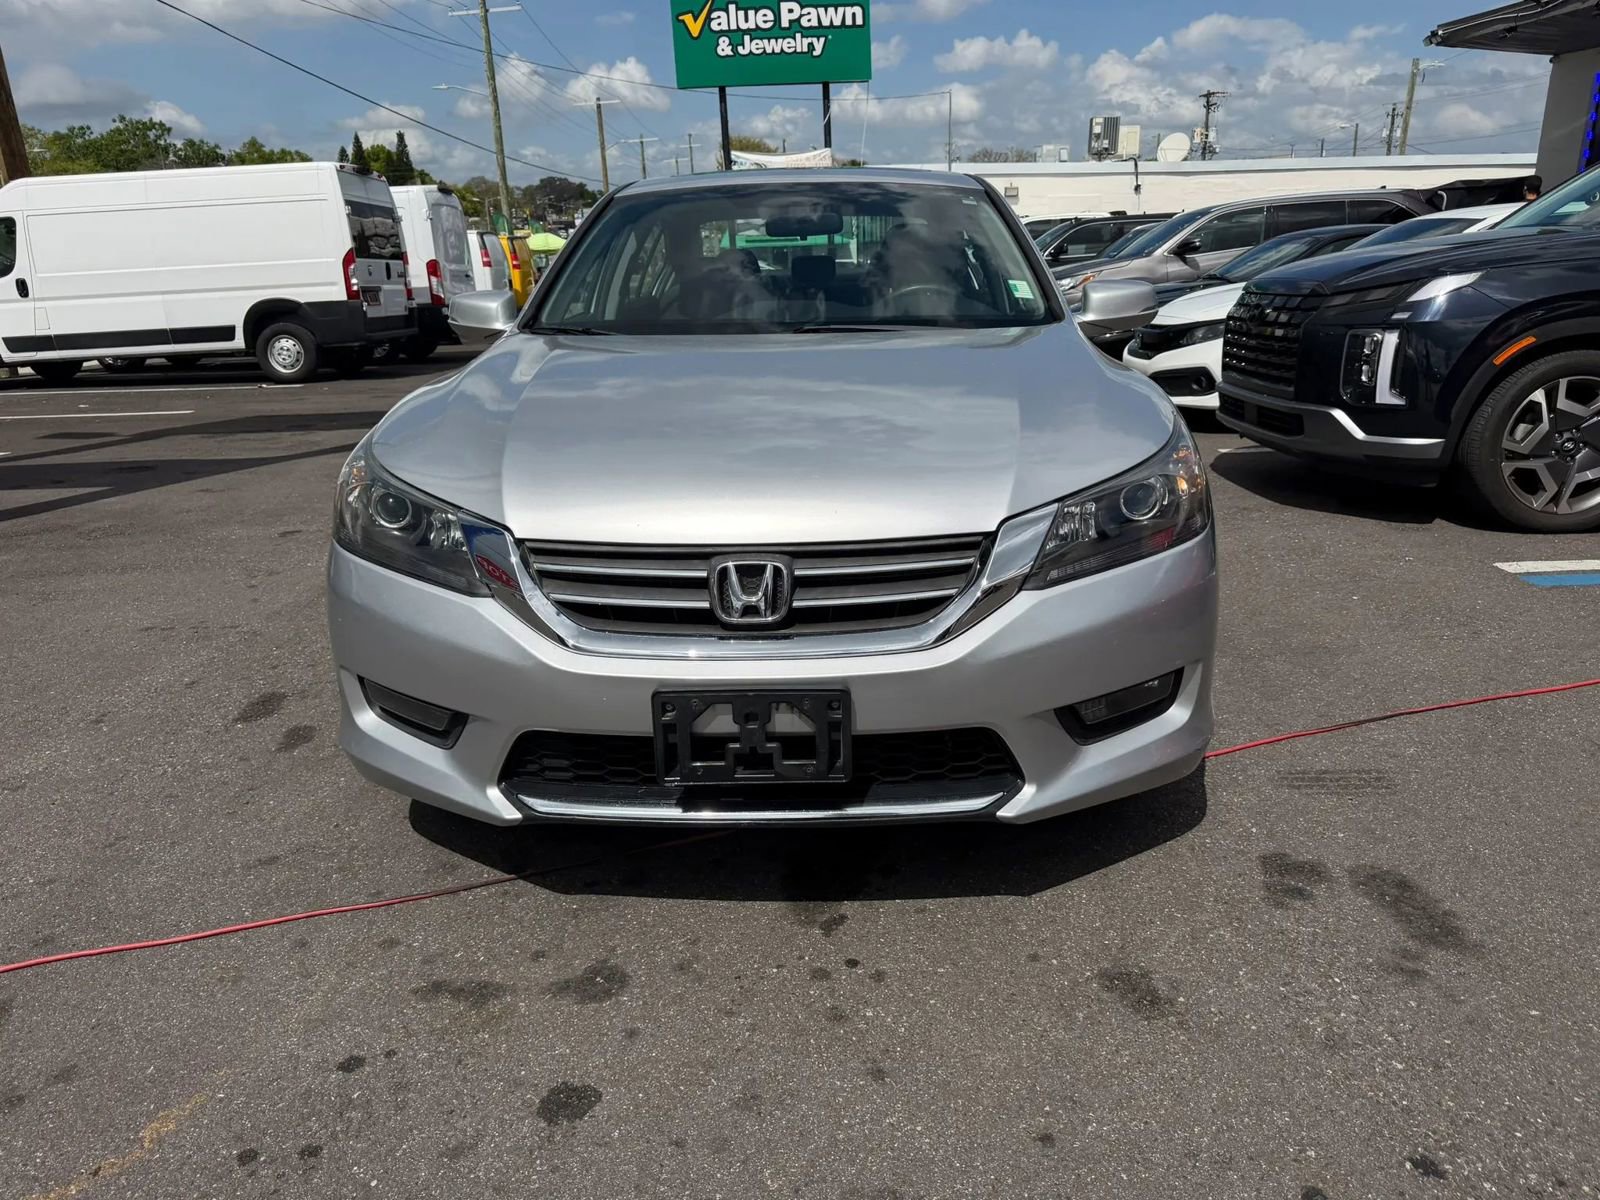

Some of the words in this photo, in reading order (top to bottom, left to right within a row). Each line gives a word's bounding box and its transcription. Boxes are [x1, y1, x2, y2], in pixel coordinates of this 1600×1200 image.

[780, 1, 863, 28] Pawn
[716, 36, 734, 56] &
[737, 33, 826, 56] Jewelry
